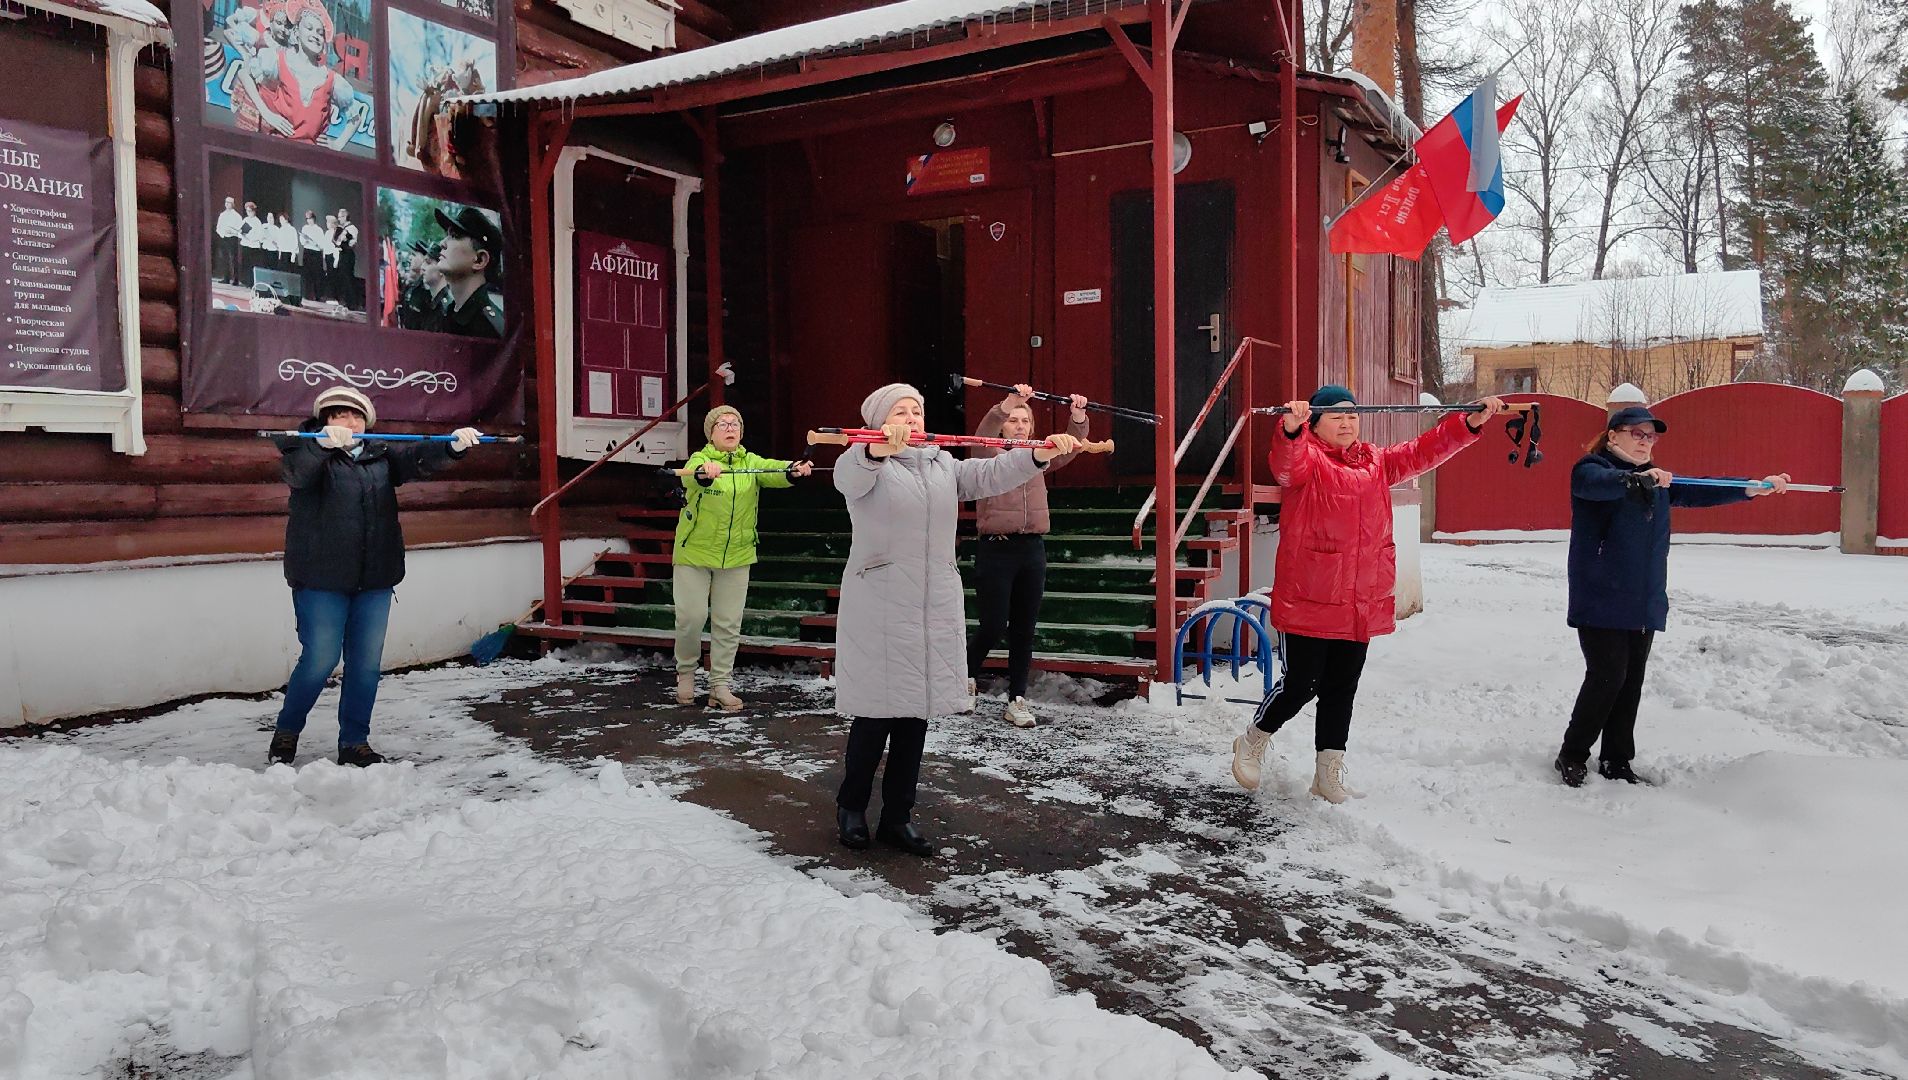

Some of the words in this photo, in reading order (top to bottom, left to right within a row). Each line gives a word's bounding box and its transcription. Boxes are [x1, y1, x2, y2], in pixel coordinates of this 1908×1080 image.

[10, 203, 67, 219] Хореография
[1394, 186, 1421, 225] ОРДЕНА
[10, 214, 74, 231] Танцевальный
[11, 227, 56, 239] коллектив
[12, 251, 68, 265] Спортивный
[12, 262, 51, 274] бальный
[53, 268, 77, 277] танец
[589, 251, 659, 281] АФИШИ
[13, 278, 72, 291] Развивающая
[14, 291, 45, 300] группа
[14, 302, 29, 310] для
[31, 303, 72, 313] малышей
[14, 315, 65, 327] Творческая
[15, 329, 65, 339] мастерская
[15, 343, 60, 354] Цирковая
[61, 347, 90, 356] студия
[16, 361, 74, 371] Рукопашный
[76, 363, 92, 372] бой
